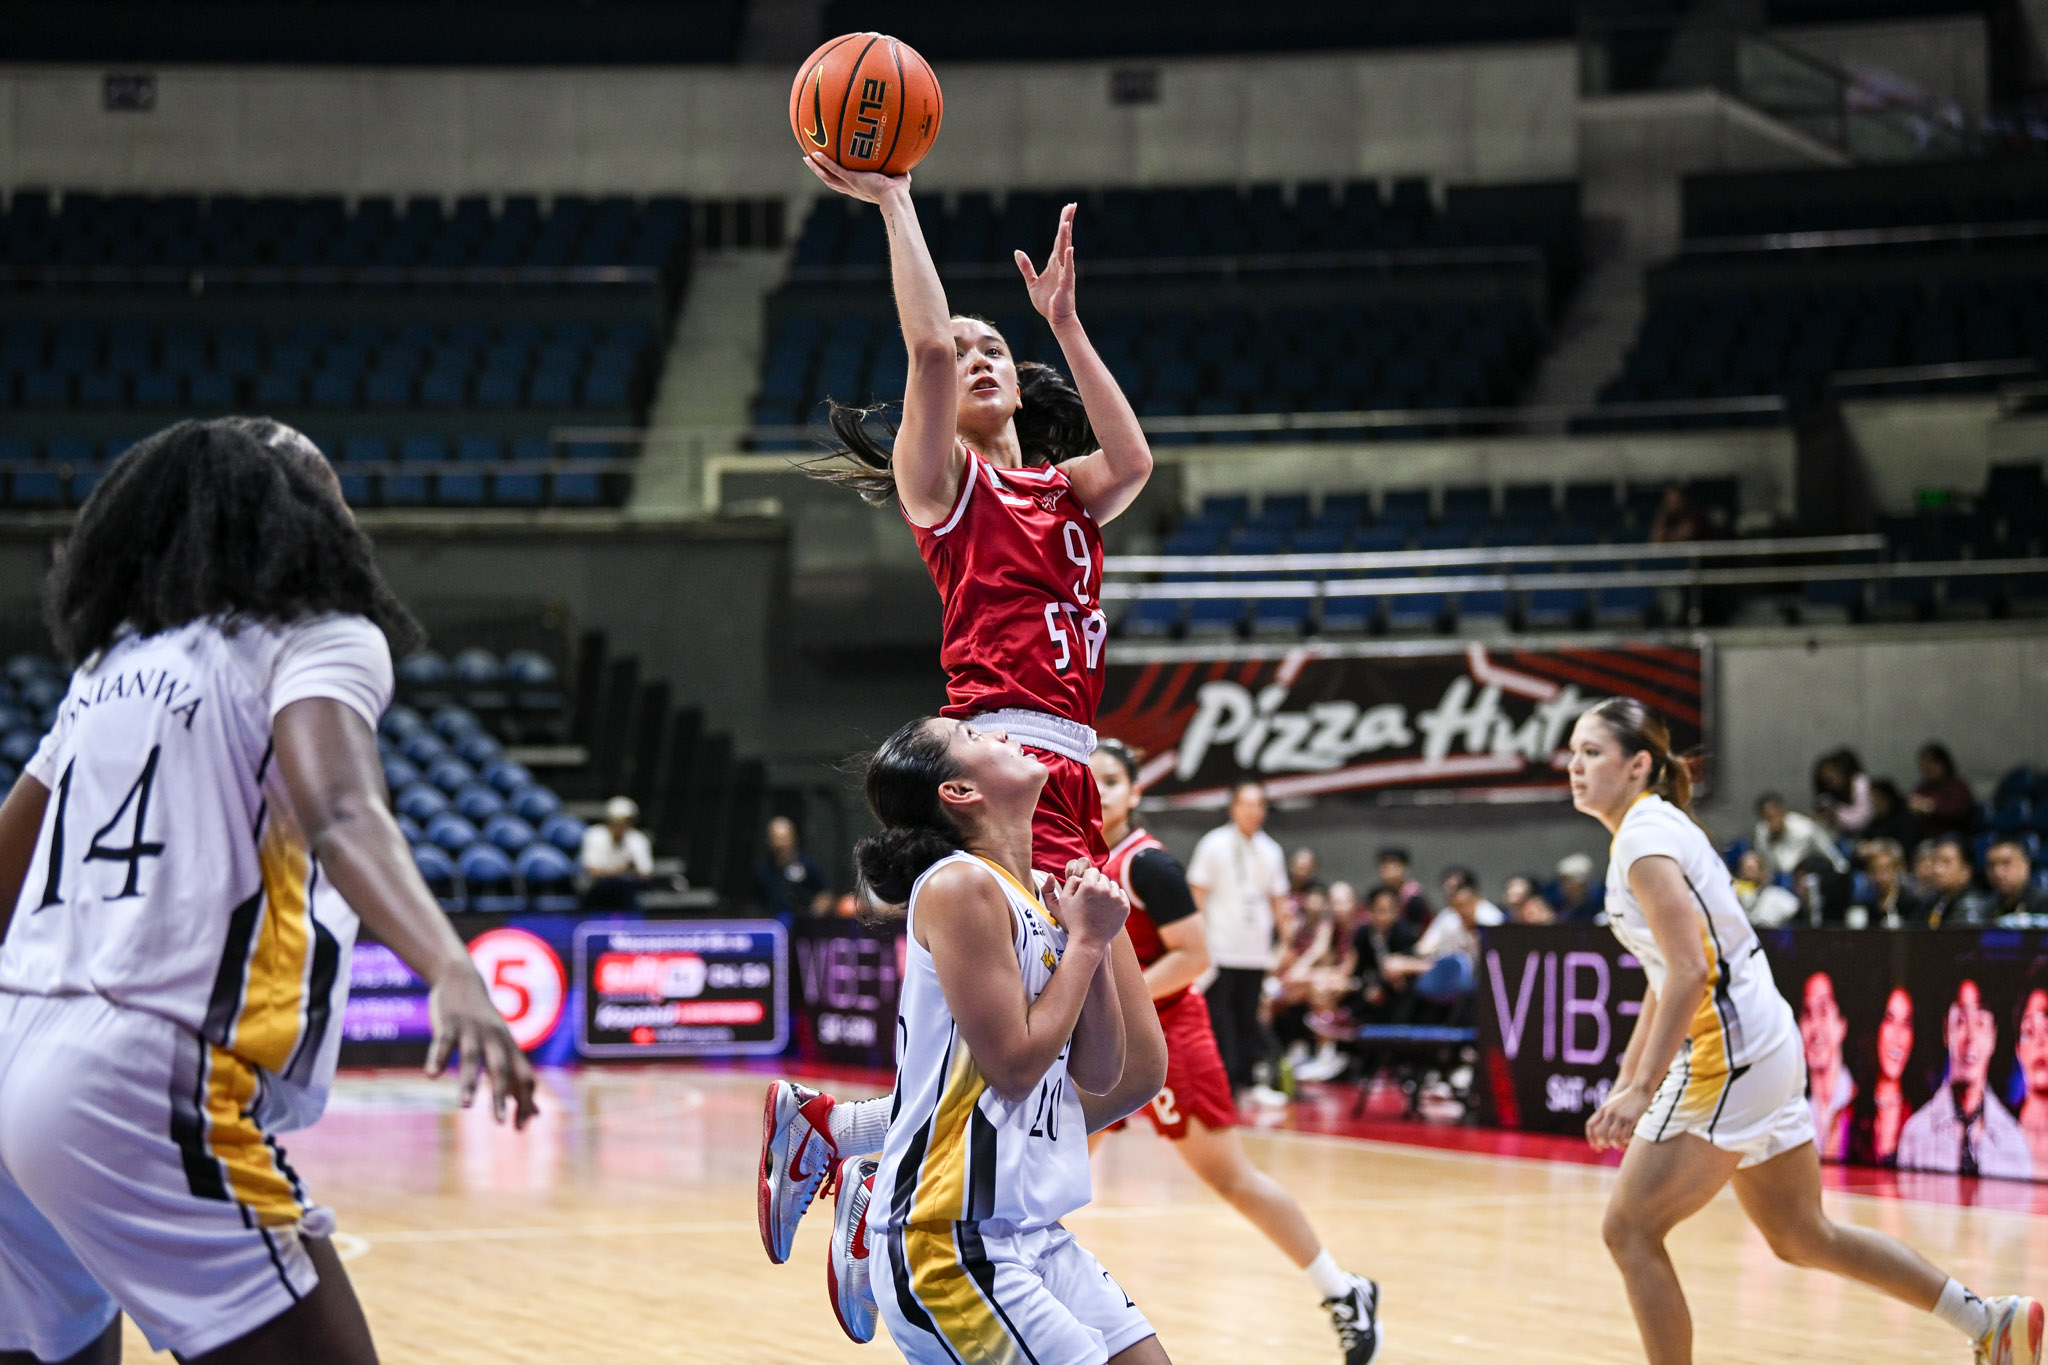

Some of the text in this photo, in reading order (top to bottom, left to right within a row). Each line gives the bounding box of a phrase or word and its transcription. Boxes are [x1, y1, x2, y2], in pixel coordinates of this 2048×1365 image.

[849, 78, 887, 160] ELITE
[1063, 520, 1091, 605] 9
[1177, 674, 1597, 780] Pizza Hut
[31, 743, 165, 915] 14
[493, 959, 530, 1022] 5
[1029, 1076, 1062, 1142] 20
